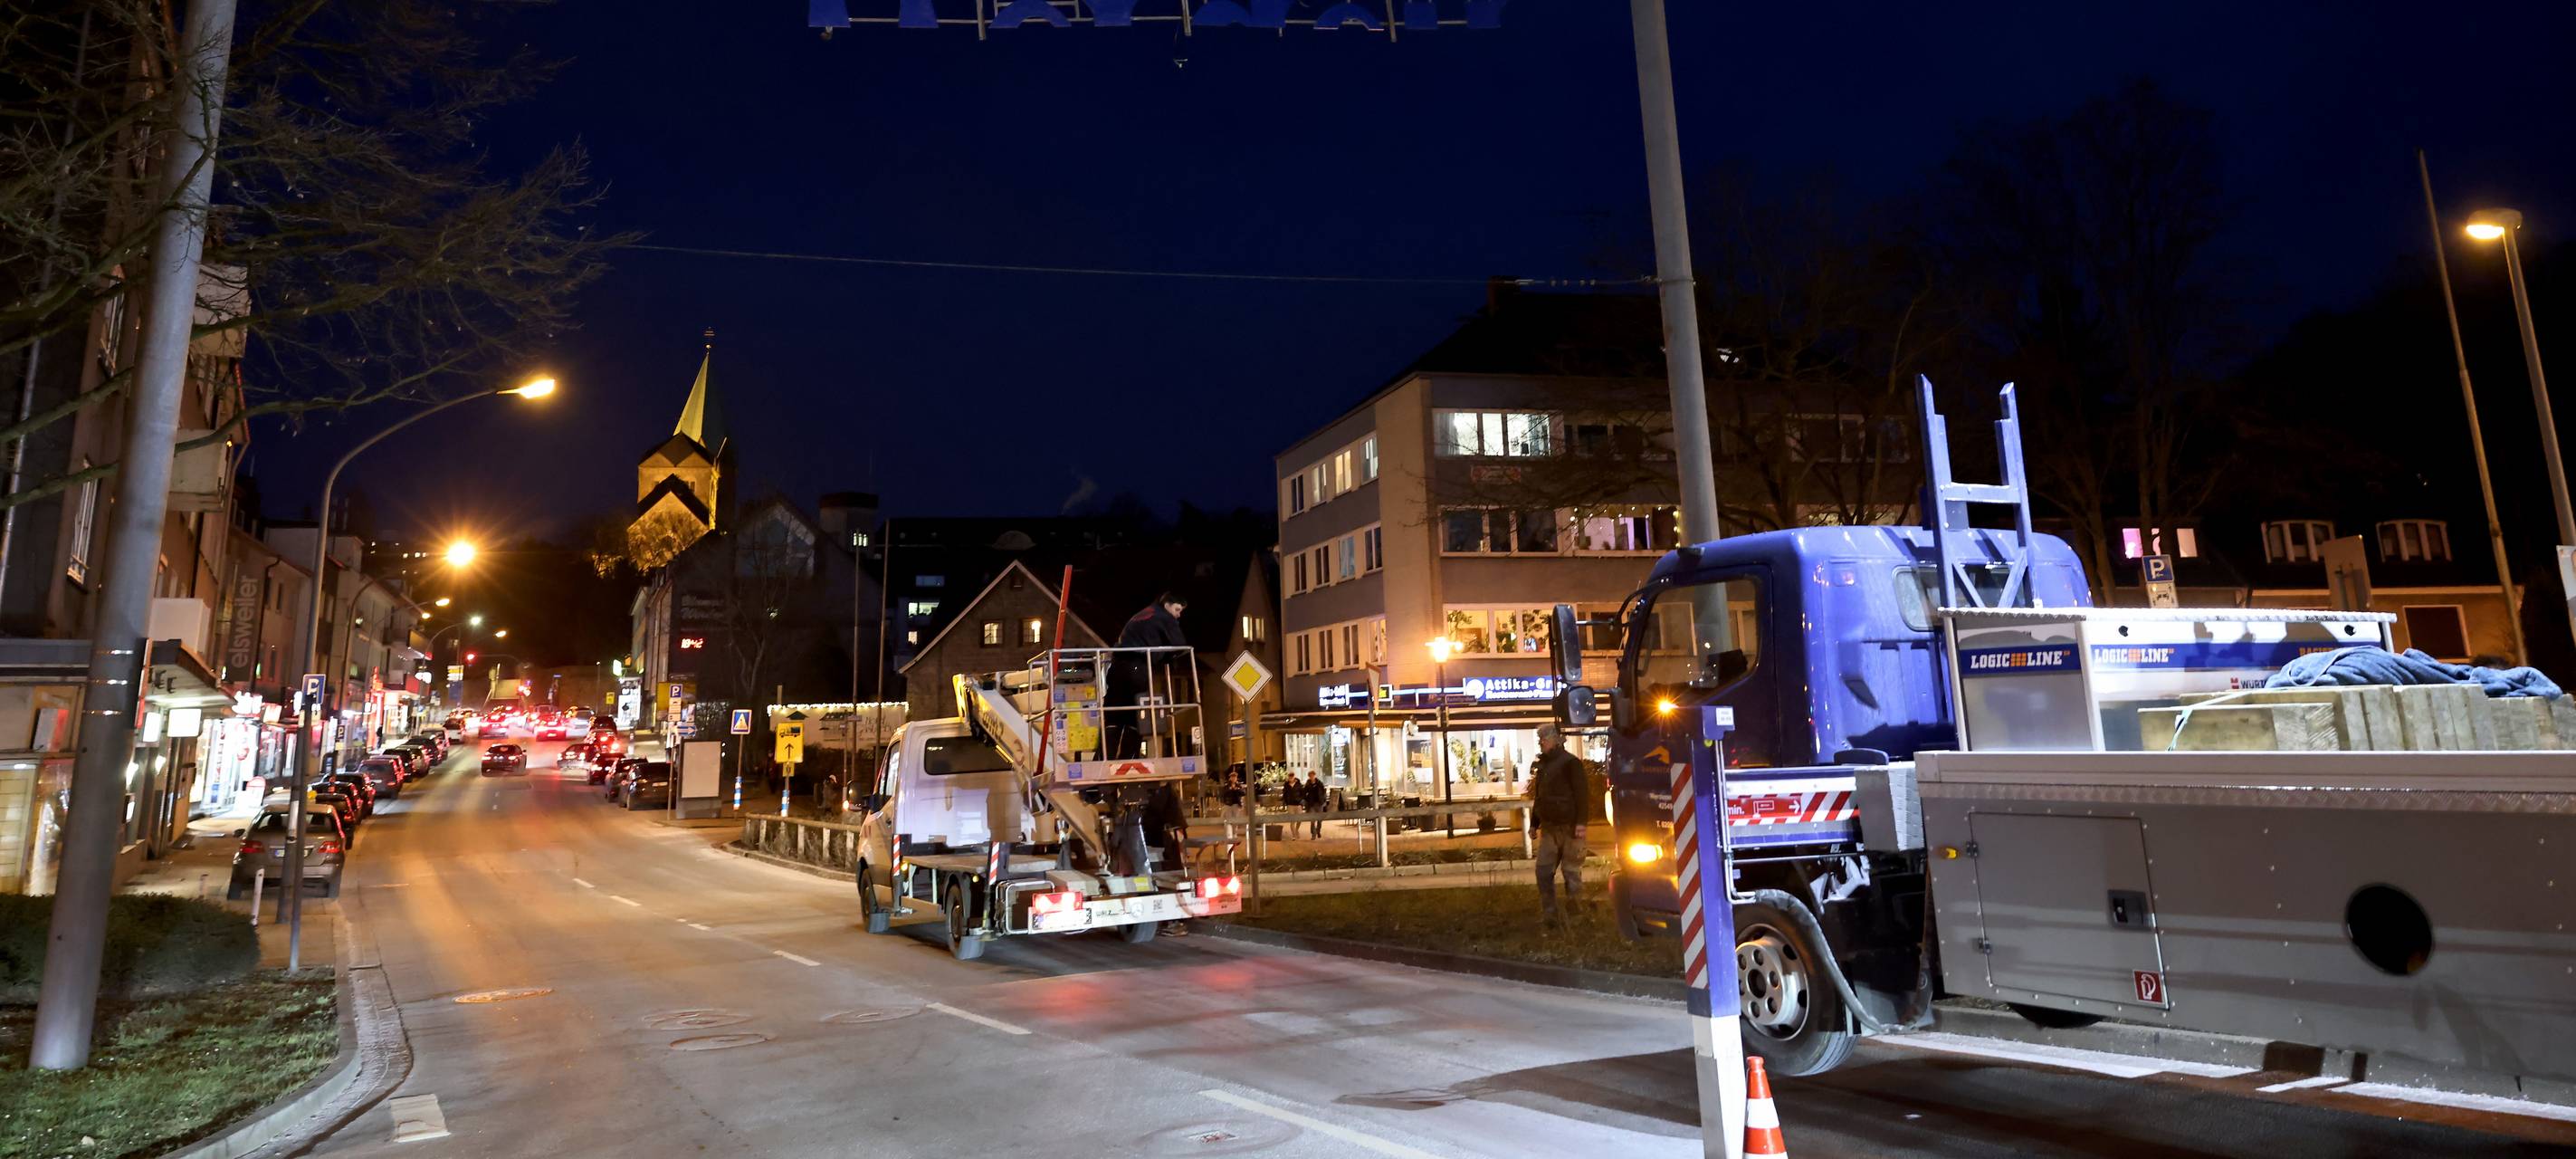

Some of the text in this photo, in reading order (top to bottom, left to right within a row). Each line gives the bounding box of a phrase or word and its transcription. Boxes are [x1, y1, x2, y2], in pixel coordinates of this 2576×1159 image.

[2150, 559, 2164, 580] P
[1970, 650, 2063, 669] LOGIC LINE
[2094, 648, 2170, 663] LOGIC LINE
[2240, 679, 2266, 689] WÜRT
